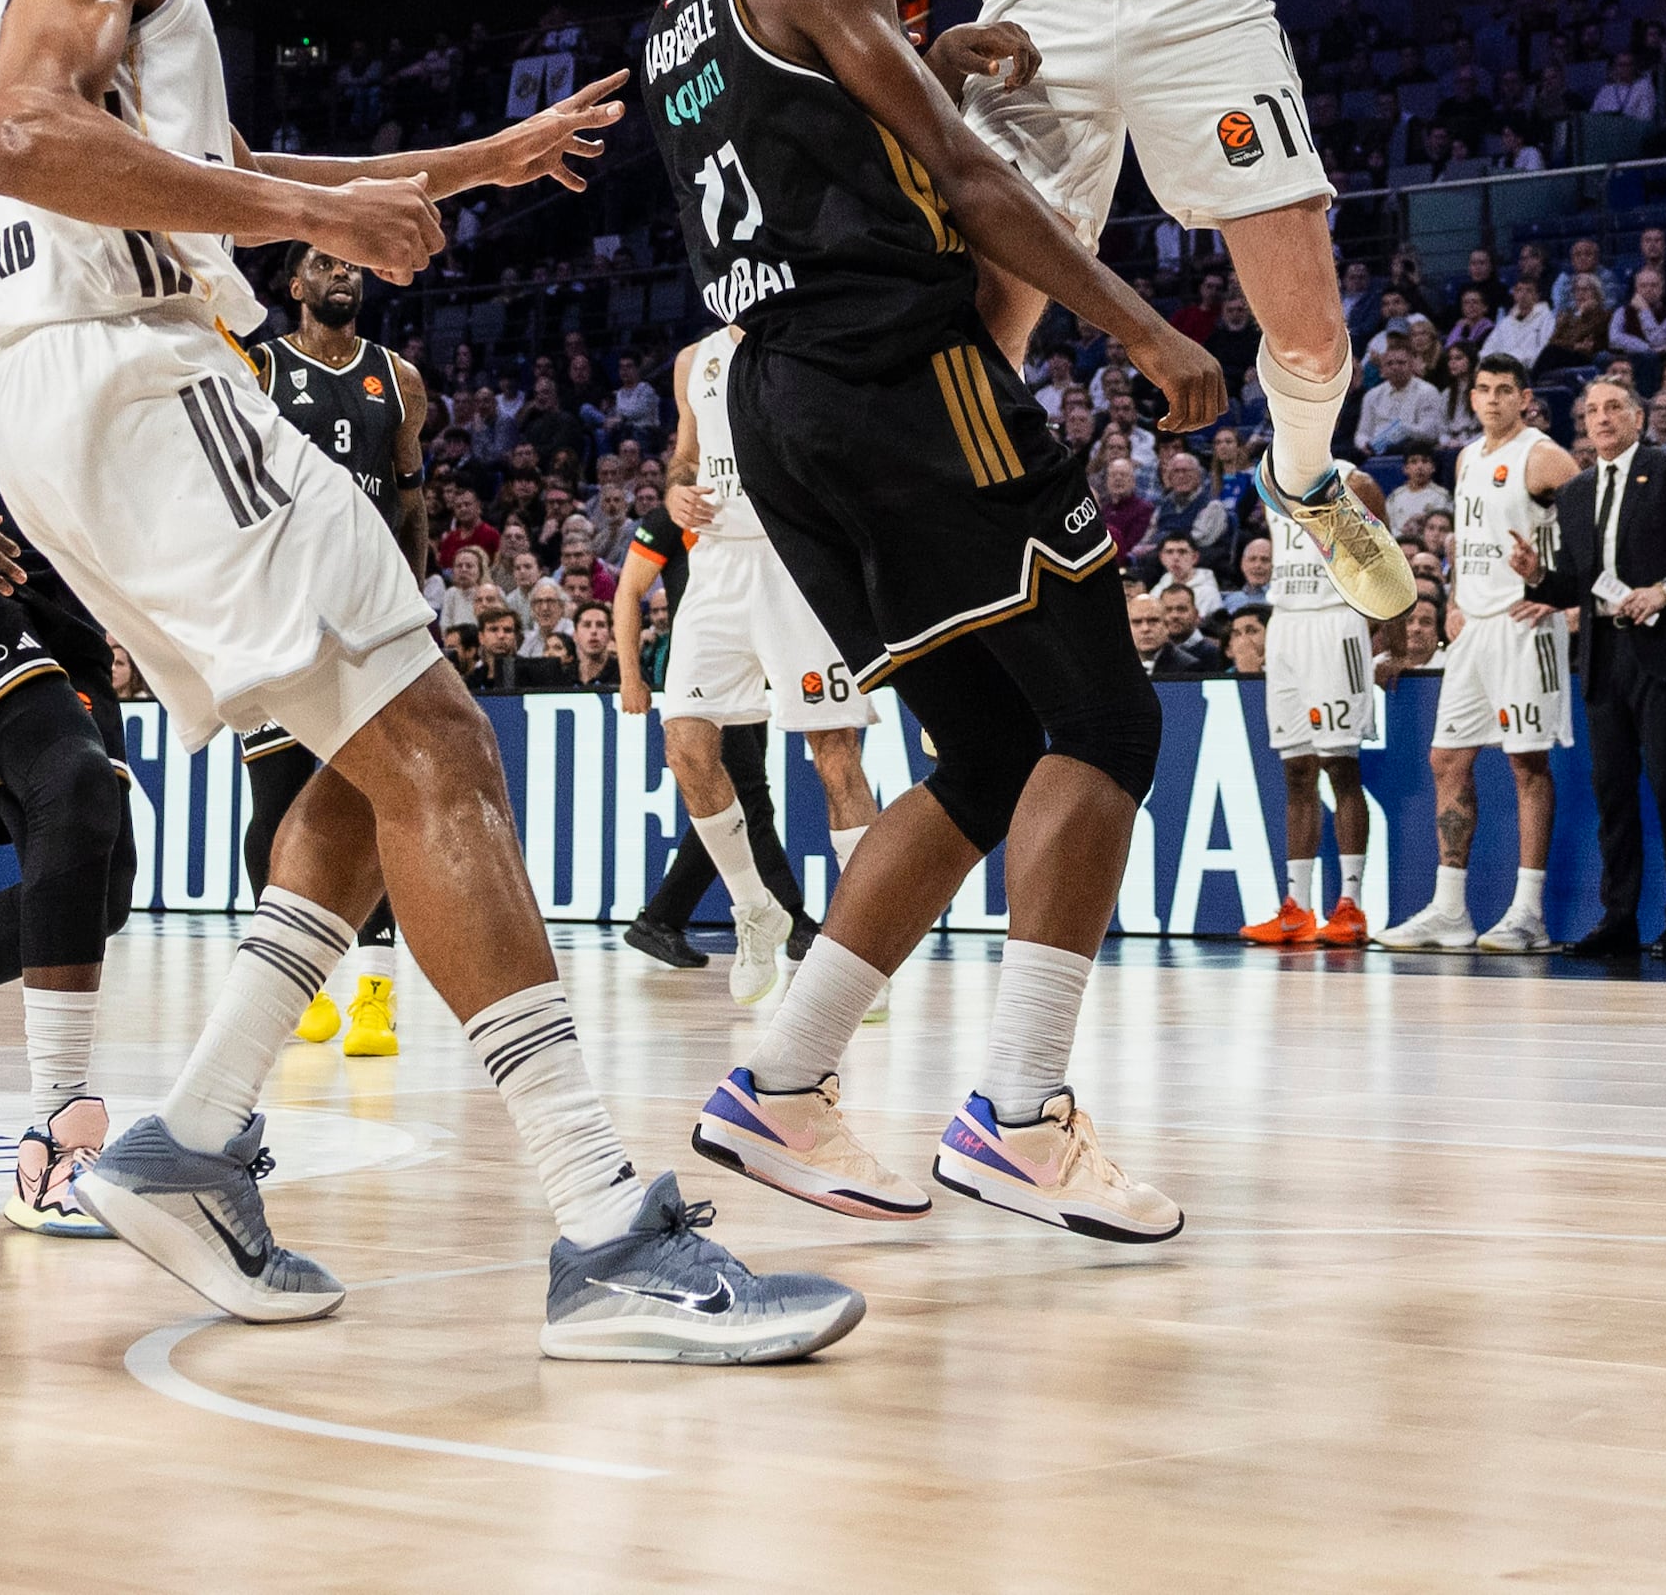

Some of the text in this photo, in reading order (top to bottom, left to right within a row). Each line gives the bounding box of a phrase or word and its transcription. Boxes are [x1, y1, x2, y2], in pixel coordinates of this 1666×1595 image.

[1253, 87, 1315, 159] 11
[703, 257, 796, 324] DUBAI
[334, 418, 351, 453] 3
[1463, 496, 1483, 527] 14
[1284, 521, 1305, 550] 12
[1461, 538, 1503, 559] irates
[827, 661, 850, 703] 6
[1322, 700, 1351, 731] 12
[1510, 702, 1542, 735] 14
